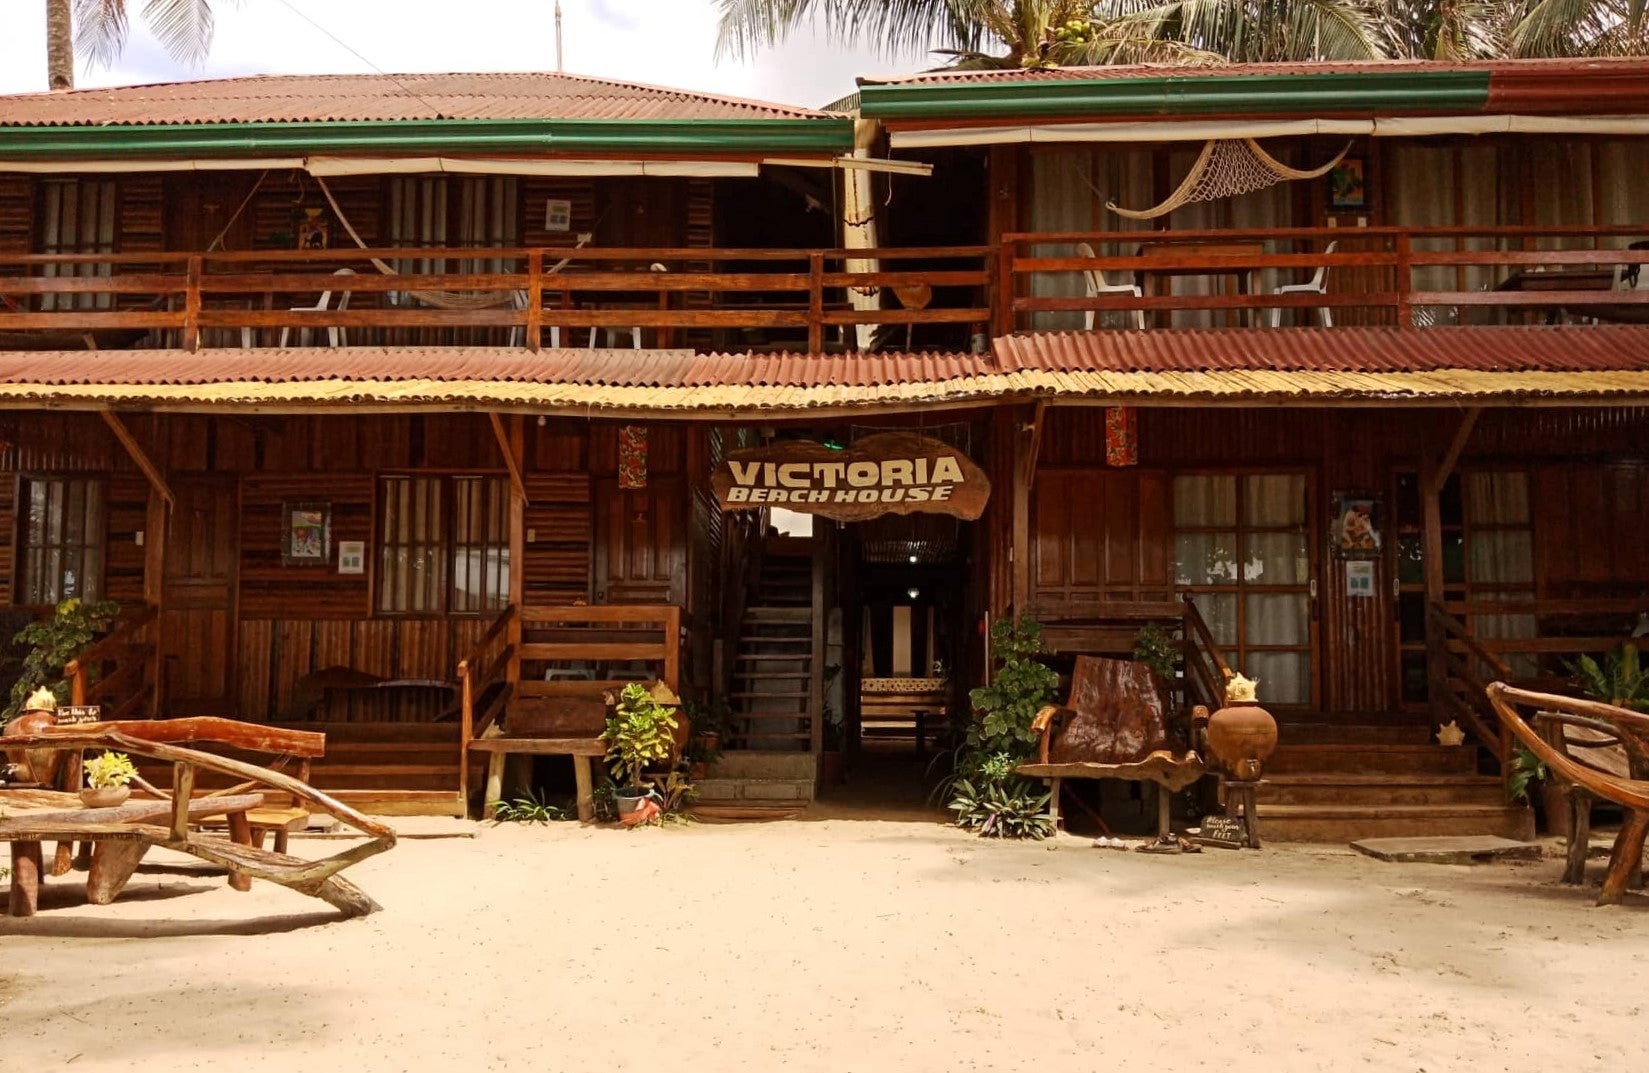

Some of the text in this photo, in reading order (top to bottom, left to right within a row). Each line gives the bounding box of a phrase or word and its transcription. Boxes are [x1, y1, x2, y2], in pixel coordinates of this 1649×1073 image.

[727, 456, 965, 488] VICTORIA
[727, 485, 954, 503] BEACH HOUSE
